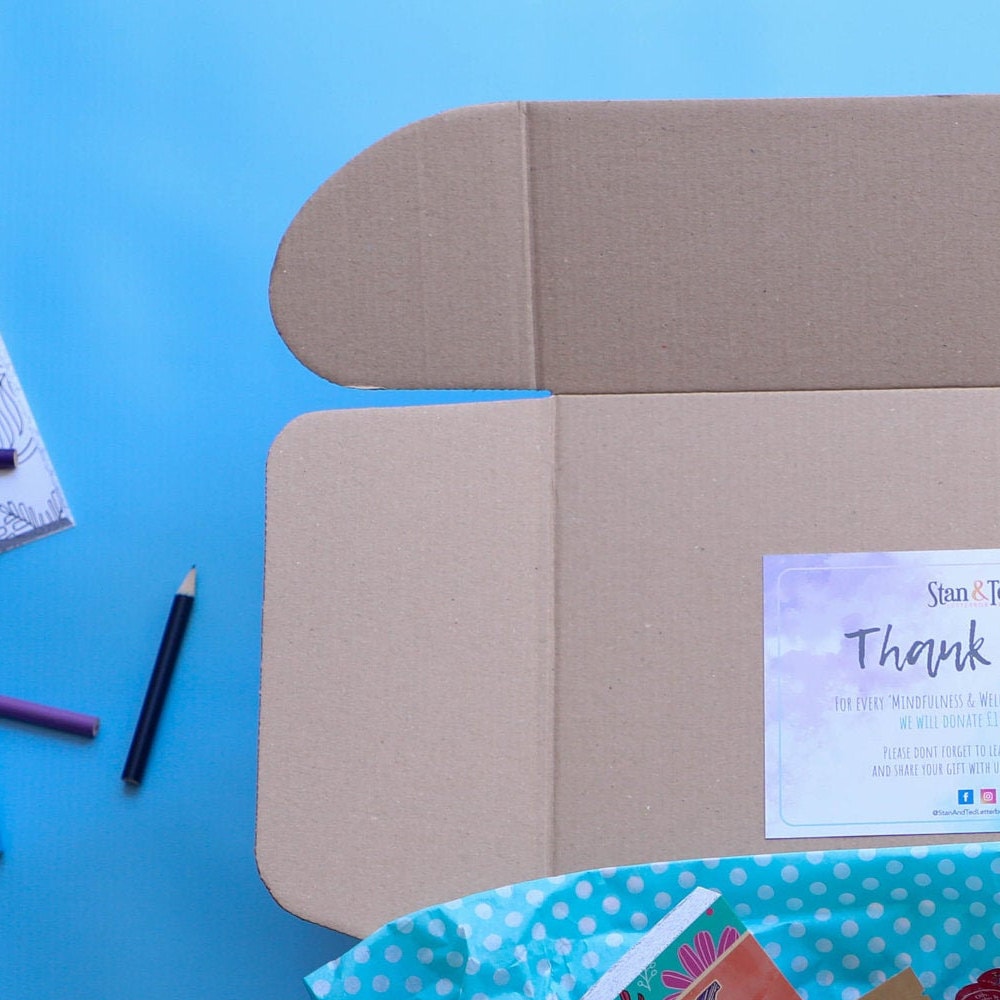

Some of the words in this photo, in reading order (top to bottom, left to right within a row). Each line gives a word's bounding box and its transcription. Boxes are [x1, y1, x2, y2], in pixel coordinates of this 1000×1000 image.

[927, 580, 968, 608] Stan
[971, 579, 989, 602] &
[844, 619, 992, 678] Thank
[835, 695, 851, 712] FOR
[856, 695, 884, 712] EVERY
[967, 692, 976, 708] &
[900, 714, 913, 730] WE
[916, 714, 939, 729] WILL
[943, 712, 982, 729] DONATE
[883, 744, 911, 760] PLEASE
[914, 744, 938, 759] DONT
[941, 743, 972, 759] FORGET
[975, 743, 987, 758] TO
[872, 763, 891, 777] AND
[894, 762, 919, 777] SHARE
[921, 762, 943, 776] YOUR
[946, 761, 966, 776] GIFT
[969, 760, 991, 775] WITH
